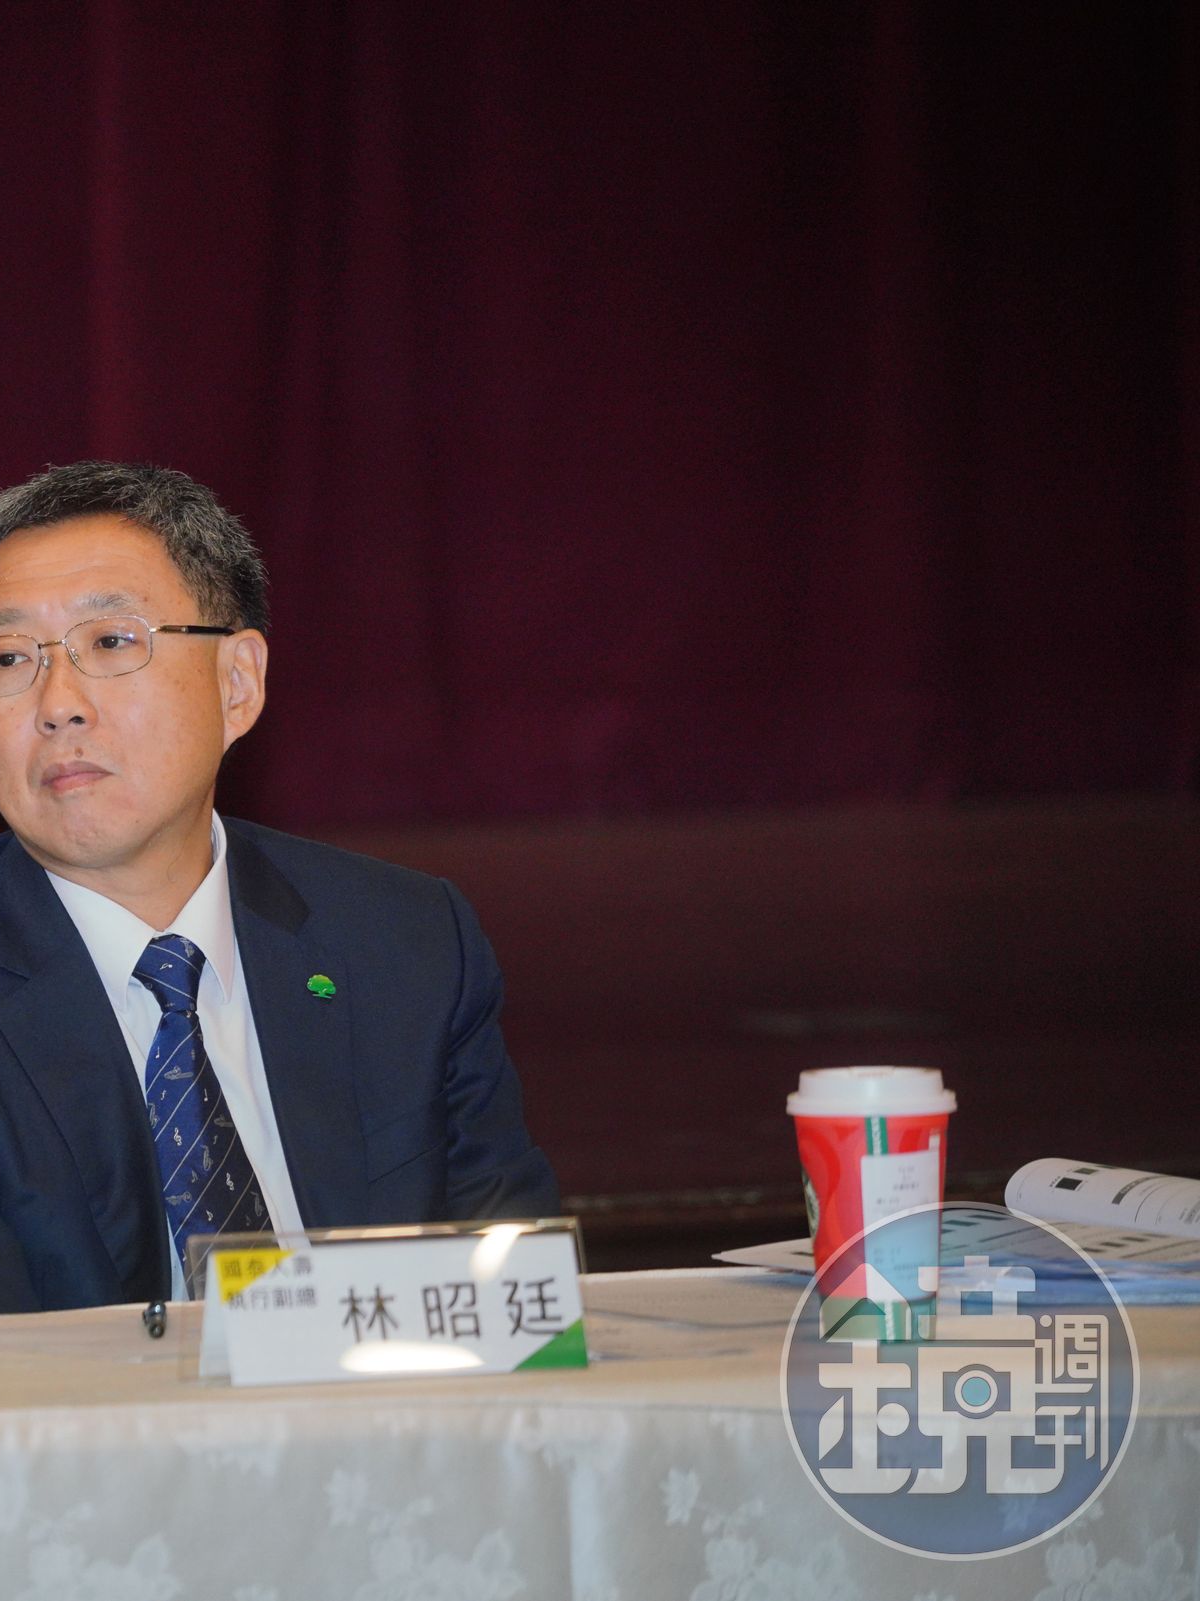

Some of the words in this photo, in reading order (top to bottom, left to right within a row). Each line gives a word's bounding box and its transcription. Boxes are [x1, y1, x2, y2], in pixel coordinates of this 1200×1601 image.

[223, 1256, 314, 1279] 國泰人壽
[340, 1275, 565, 1343] 林昭廷
